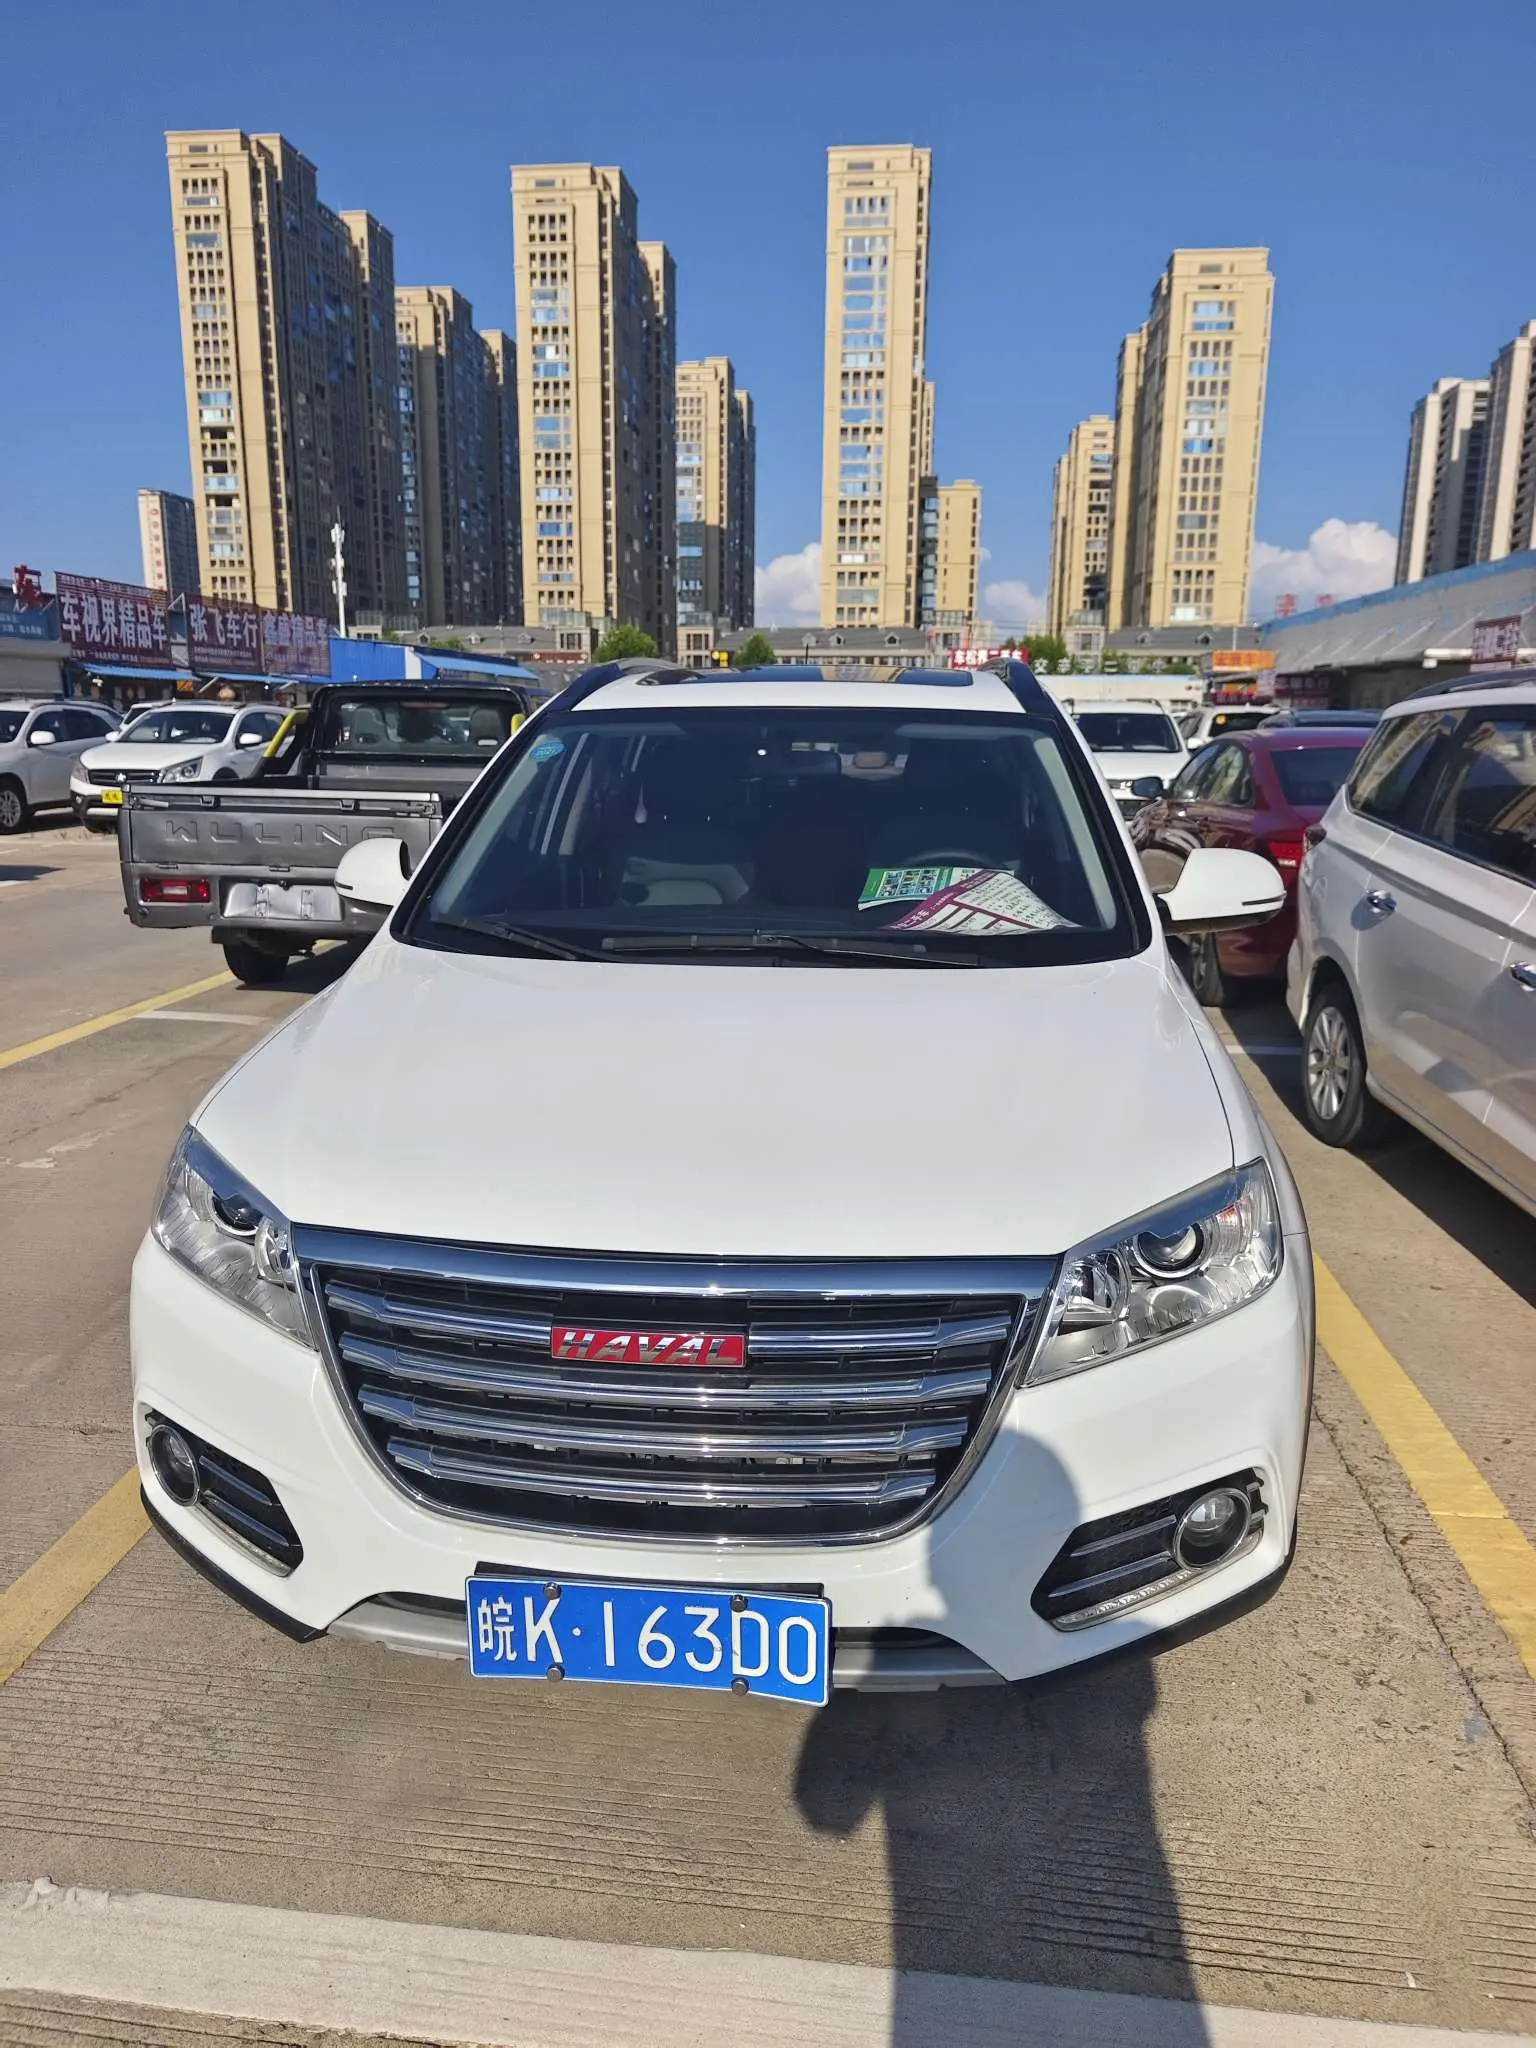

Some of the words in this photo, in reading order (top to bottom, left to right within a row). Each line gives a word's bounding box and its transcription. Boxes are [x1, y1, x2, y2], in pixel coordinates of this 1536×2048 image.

[60, 592, 167, 651] 车视界精品车
[189, 603, 258, 648] 张飞车行
[556, 1331, 738, 1365] HAVAL
